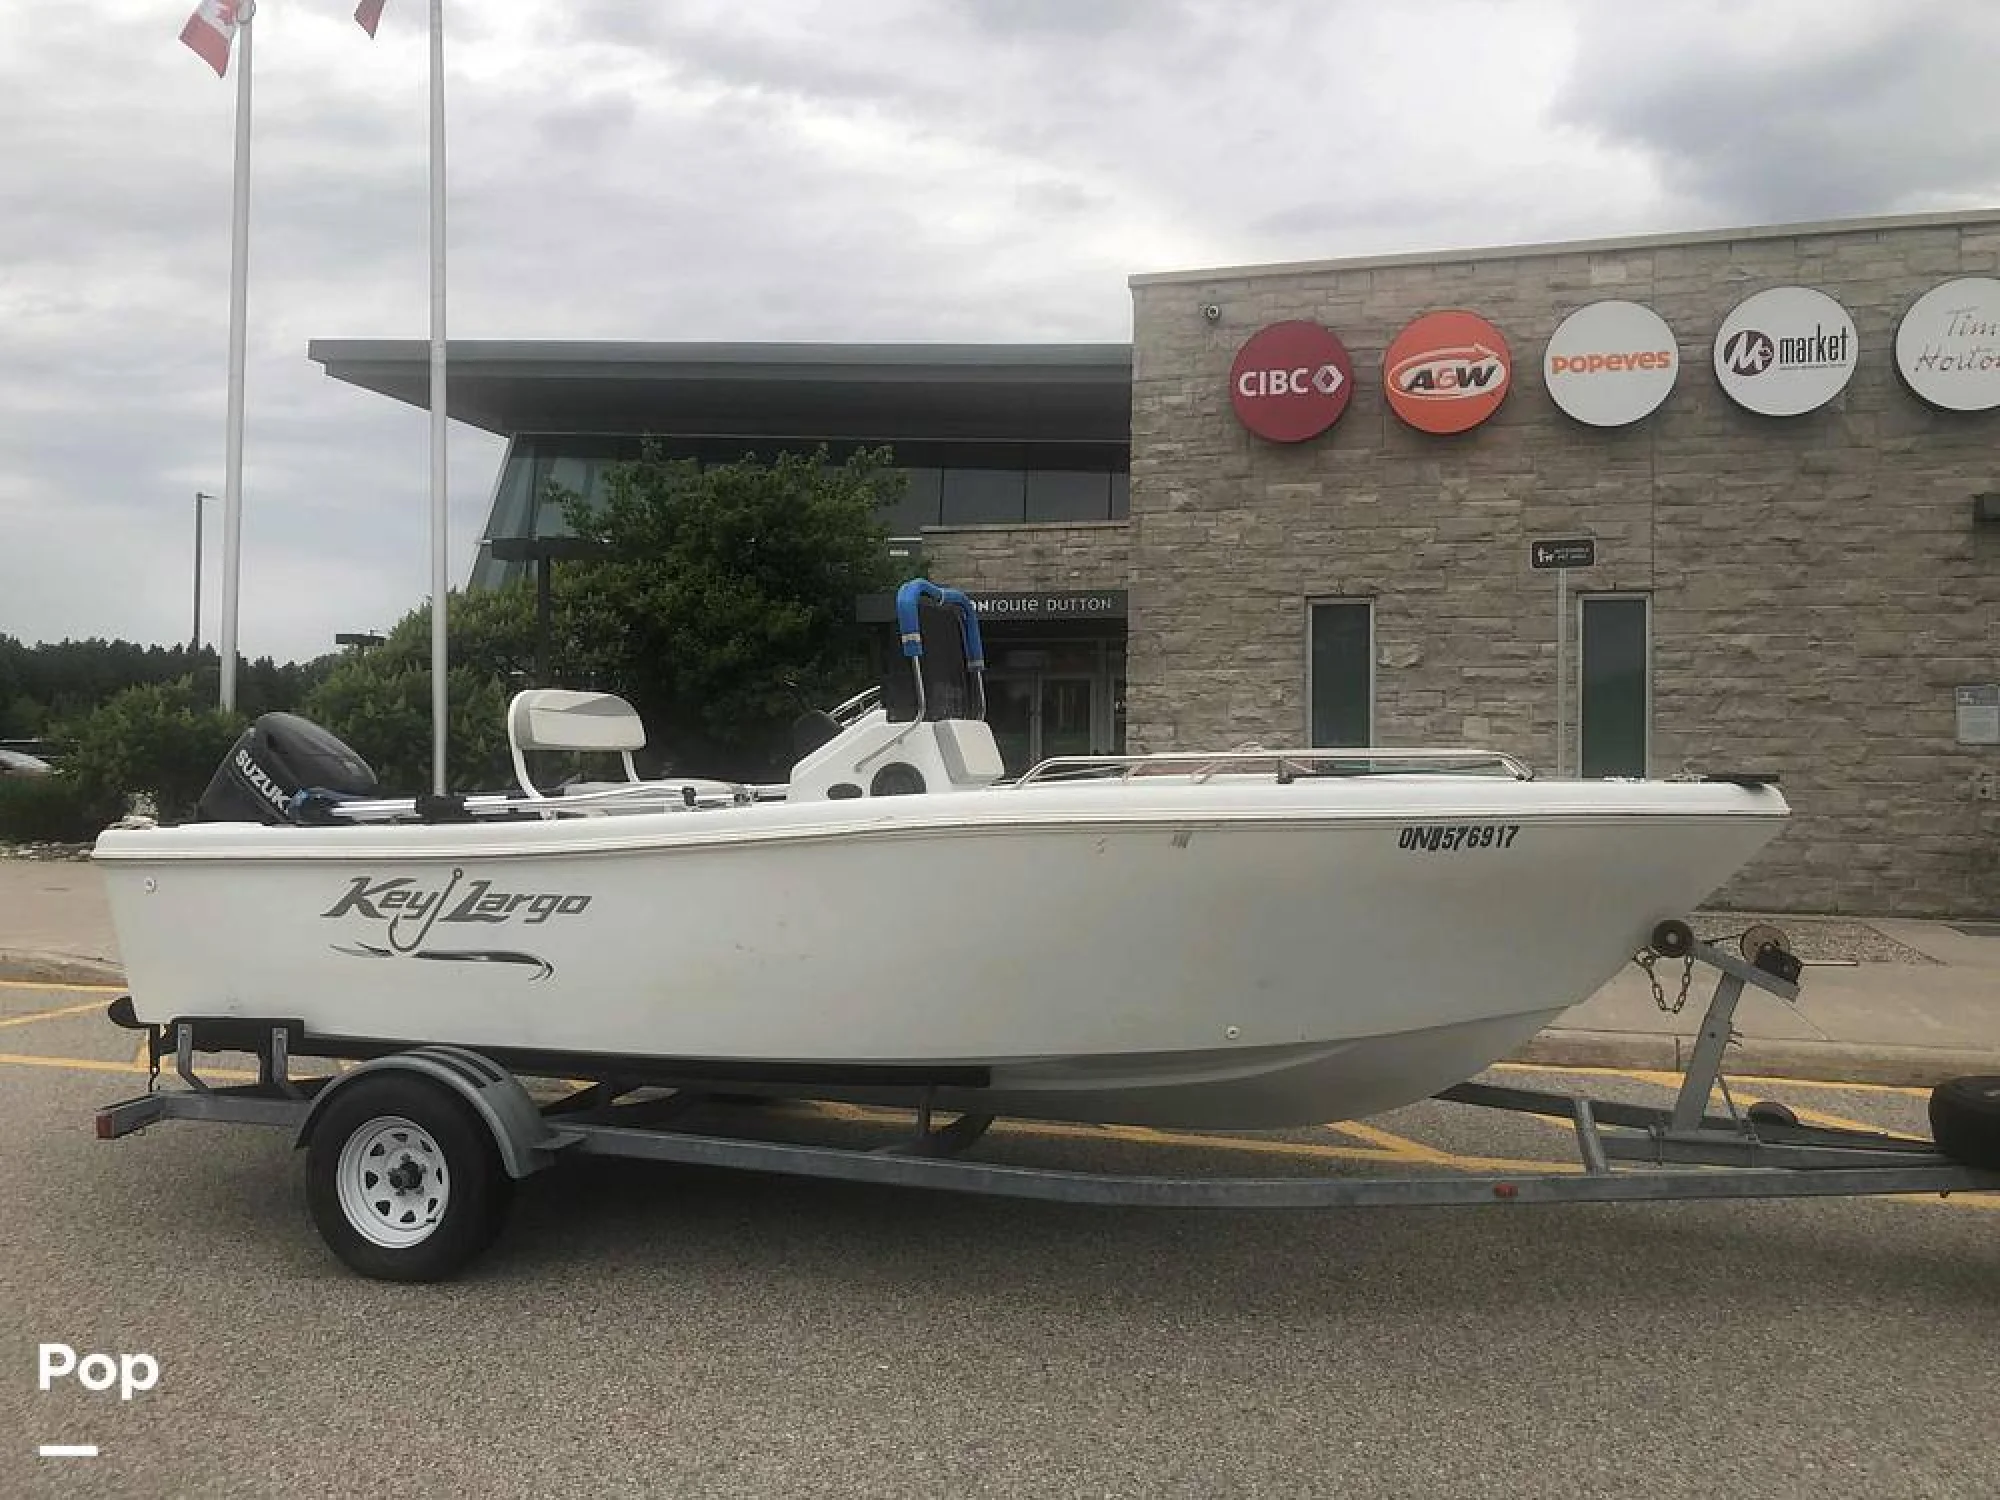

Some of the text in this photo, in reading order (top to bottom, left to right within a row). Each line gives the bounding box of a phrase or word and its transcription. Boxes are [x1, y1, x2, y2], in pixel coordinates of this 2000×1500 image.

[1779, 323, 1849, 364] market
[1914, 342, 2000, 372] Horto
[1238, 367, 1309, 396] CIBC
[1404, 363, 1499, 391] A&W
[1047, 598, 1112, 612] DUTTON
[235, 749, 291, 815] SUZUK
[320, 876, 593, 924] Key Largo
